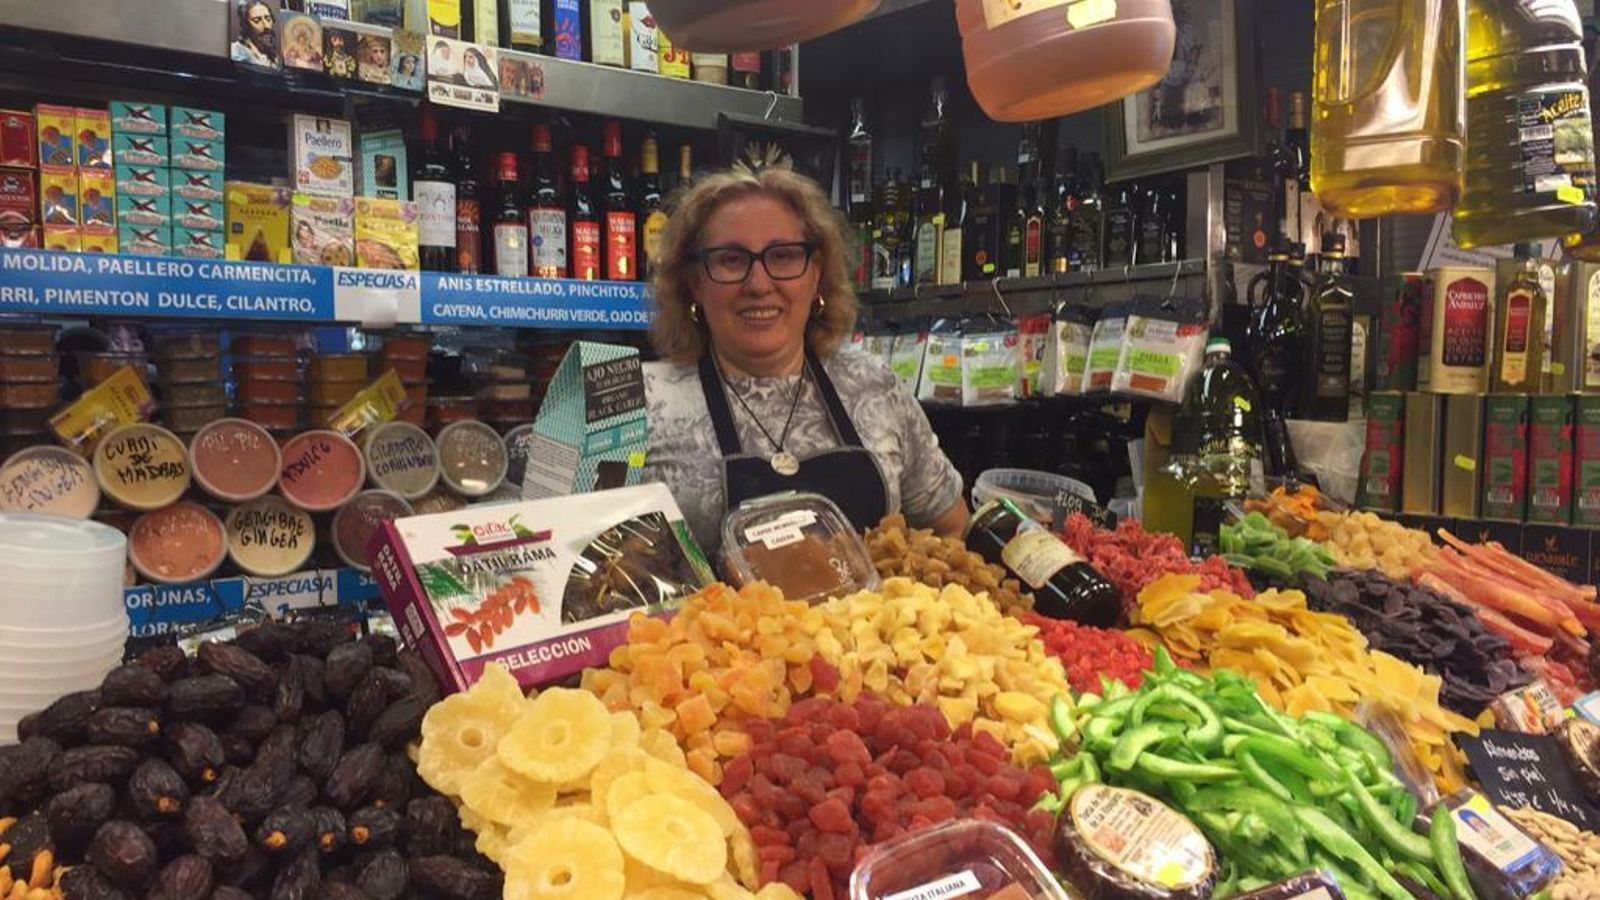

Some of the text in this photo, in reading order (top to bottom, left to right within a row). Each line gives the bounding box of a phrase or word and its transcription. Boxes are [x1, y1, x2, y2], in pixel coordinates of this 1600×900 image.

[304, 132, 342, 149] Paellero
[3, 253, 317, 286] MOLIDA, PAELLERO CARMENCITA,
[437, 276, 473, 292] ANIS
[475, 279, 567, 297] ESTRELLADO,
[568, 284, 640, 300] PINCHITOS,
[44, 288, 149, 307] PIMENTON
[157, 292, 223, 312] DULCE,
[226, 295, 317, 315] CILANTRO,
[432, 303, 649, 324] CAYENA, CHIMICHURRI VERDE, OJO DE
